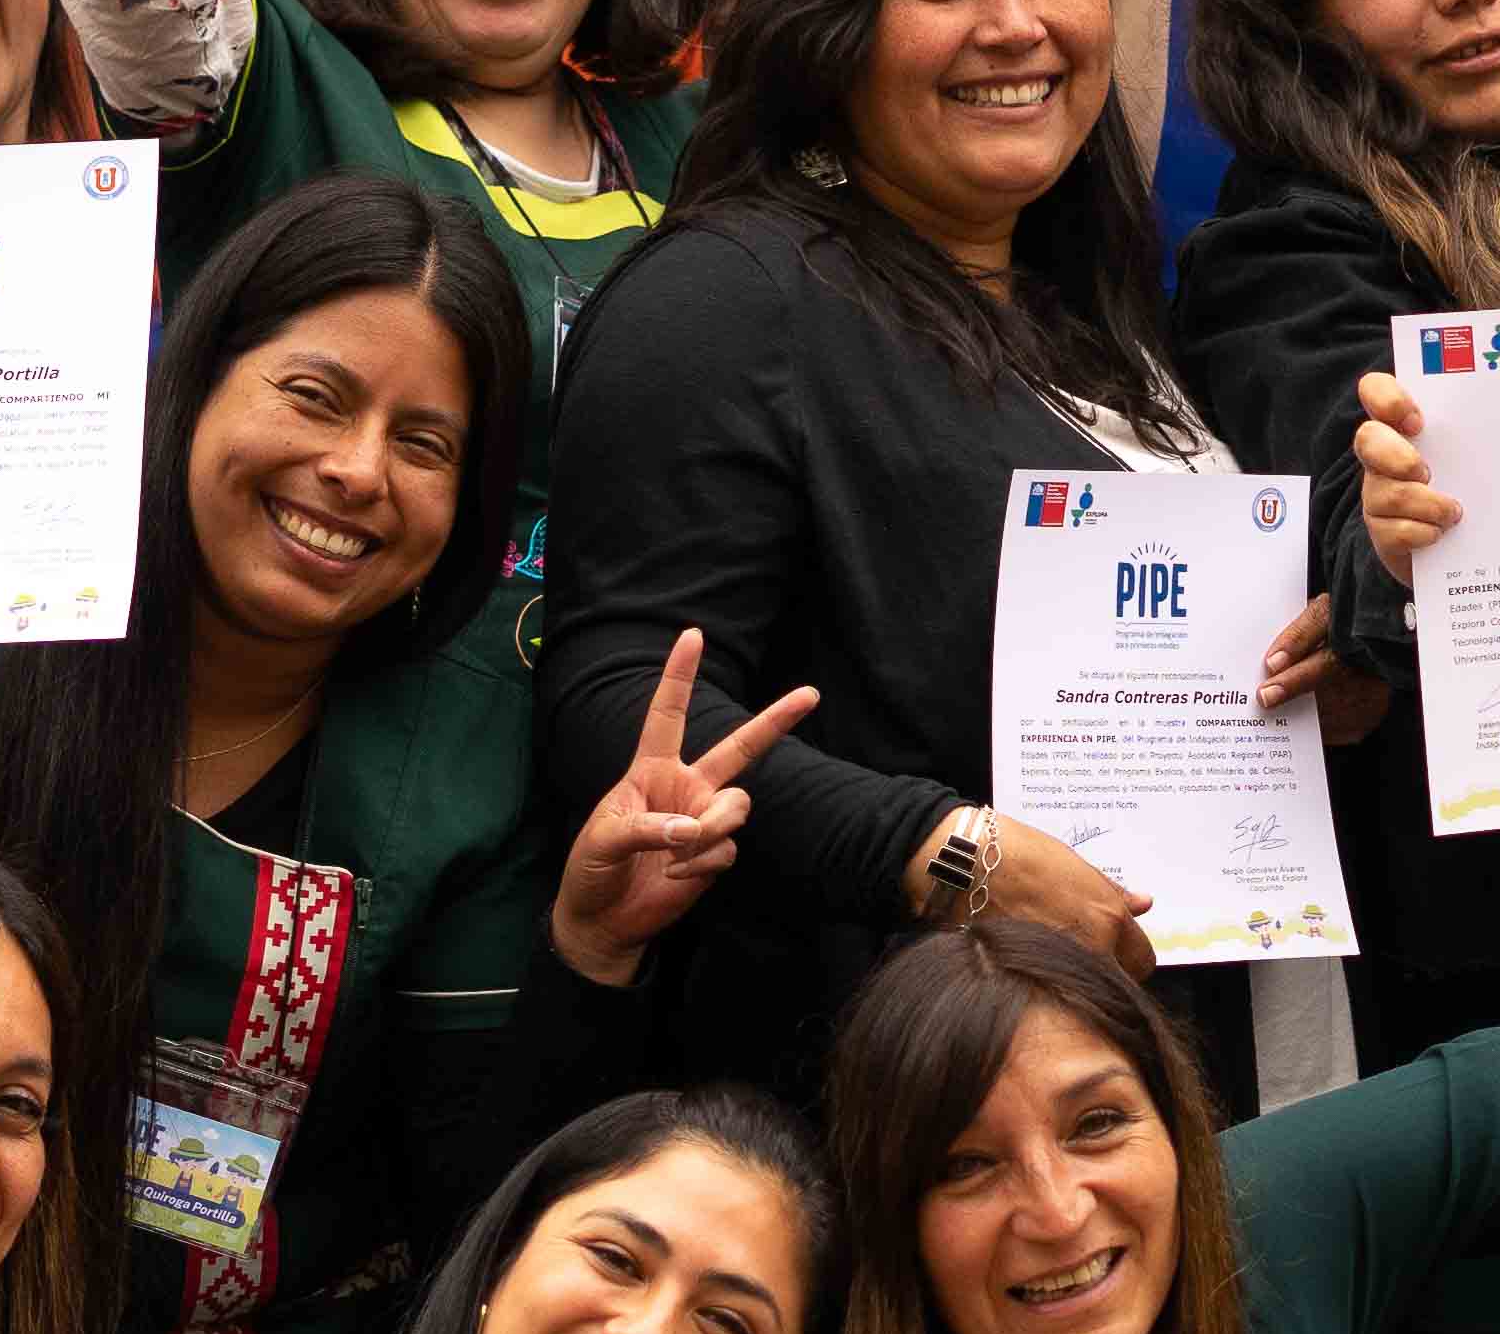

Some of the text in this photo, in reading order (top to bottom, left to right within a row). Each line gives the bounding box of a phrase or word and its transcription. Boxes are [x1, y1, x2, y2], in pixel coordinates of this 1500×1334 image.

[1116, 562, 1188, 618] PIPE
[1055, 689, 1248, 705] Sandra Contreras Portilla
[1195, 718, 1289, 728] COMPARTIENDO MI
[1020, 733, 1117, 743] EXPERIENCIA EN PIPE
[143, 1186, 237, 1225] Quiroga Portilla
